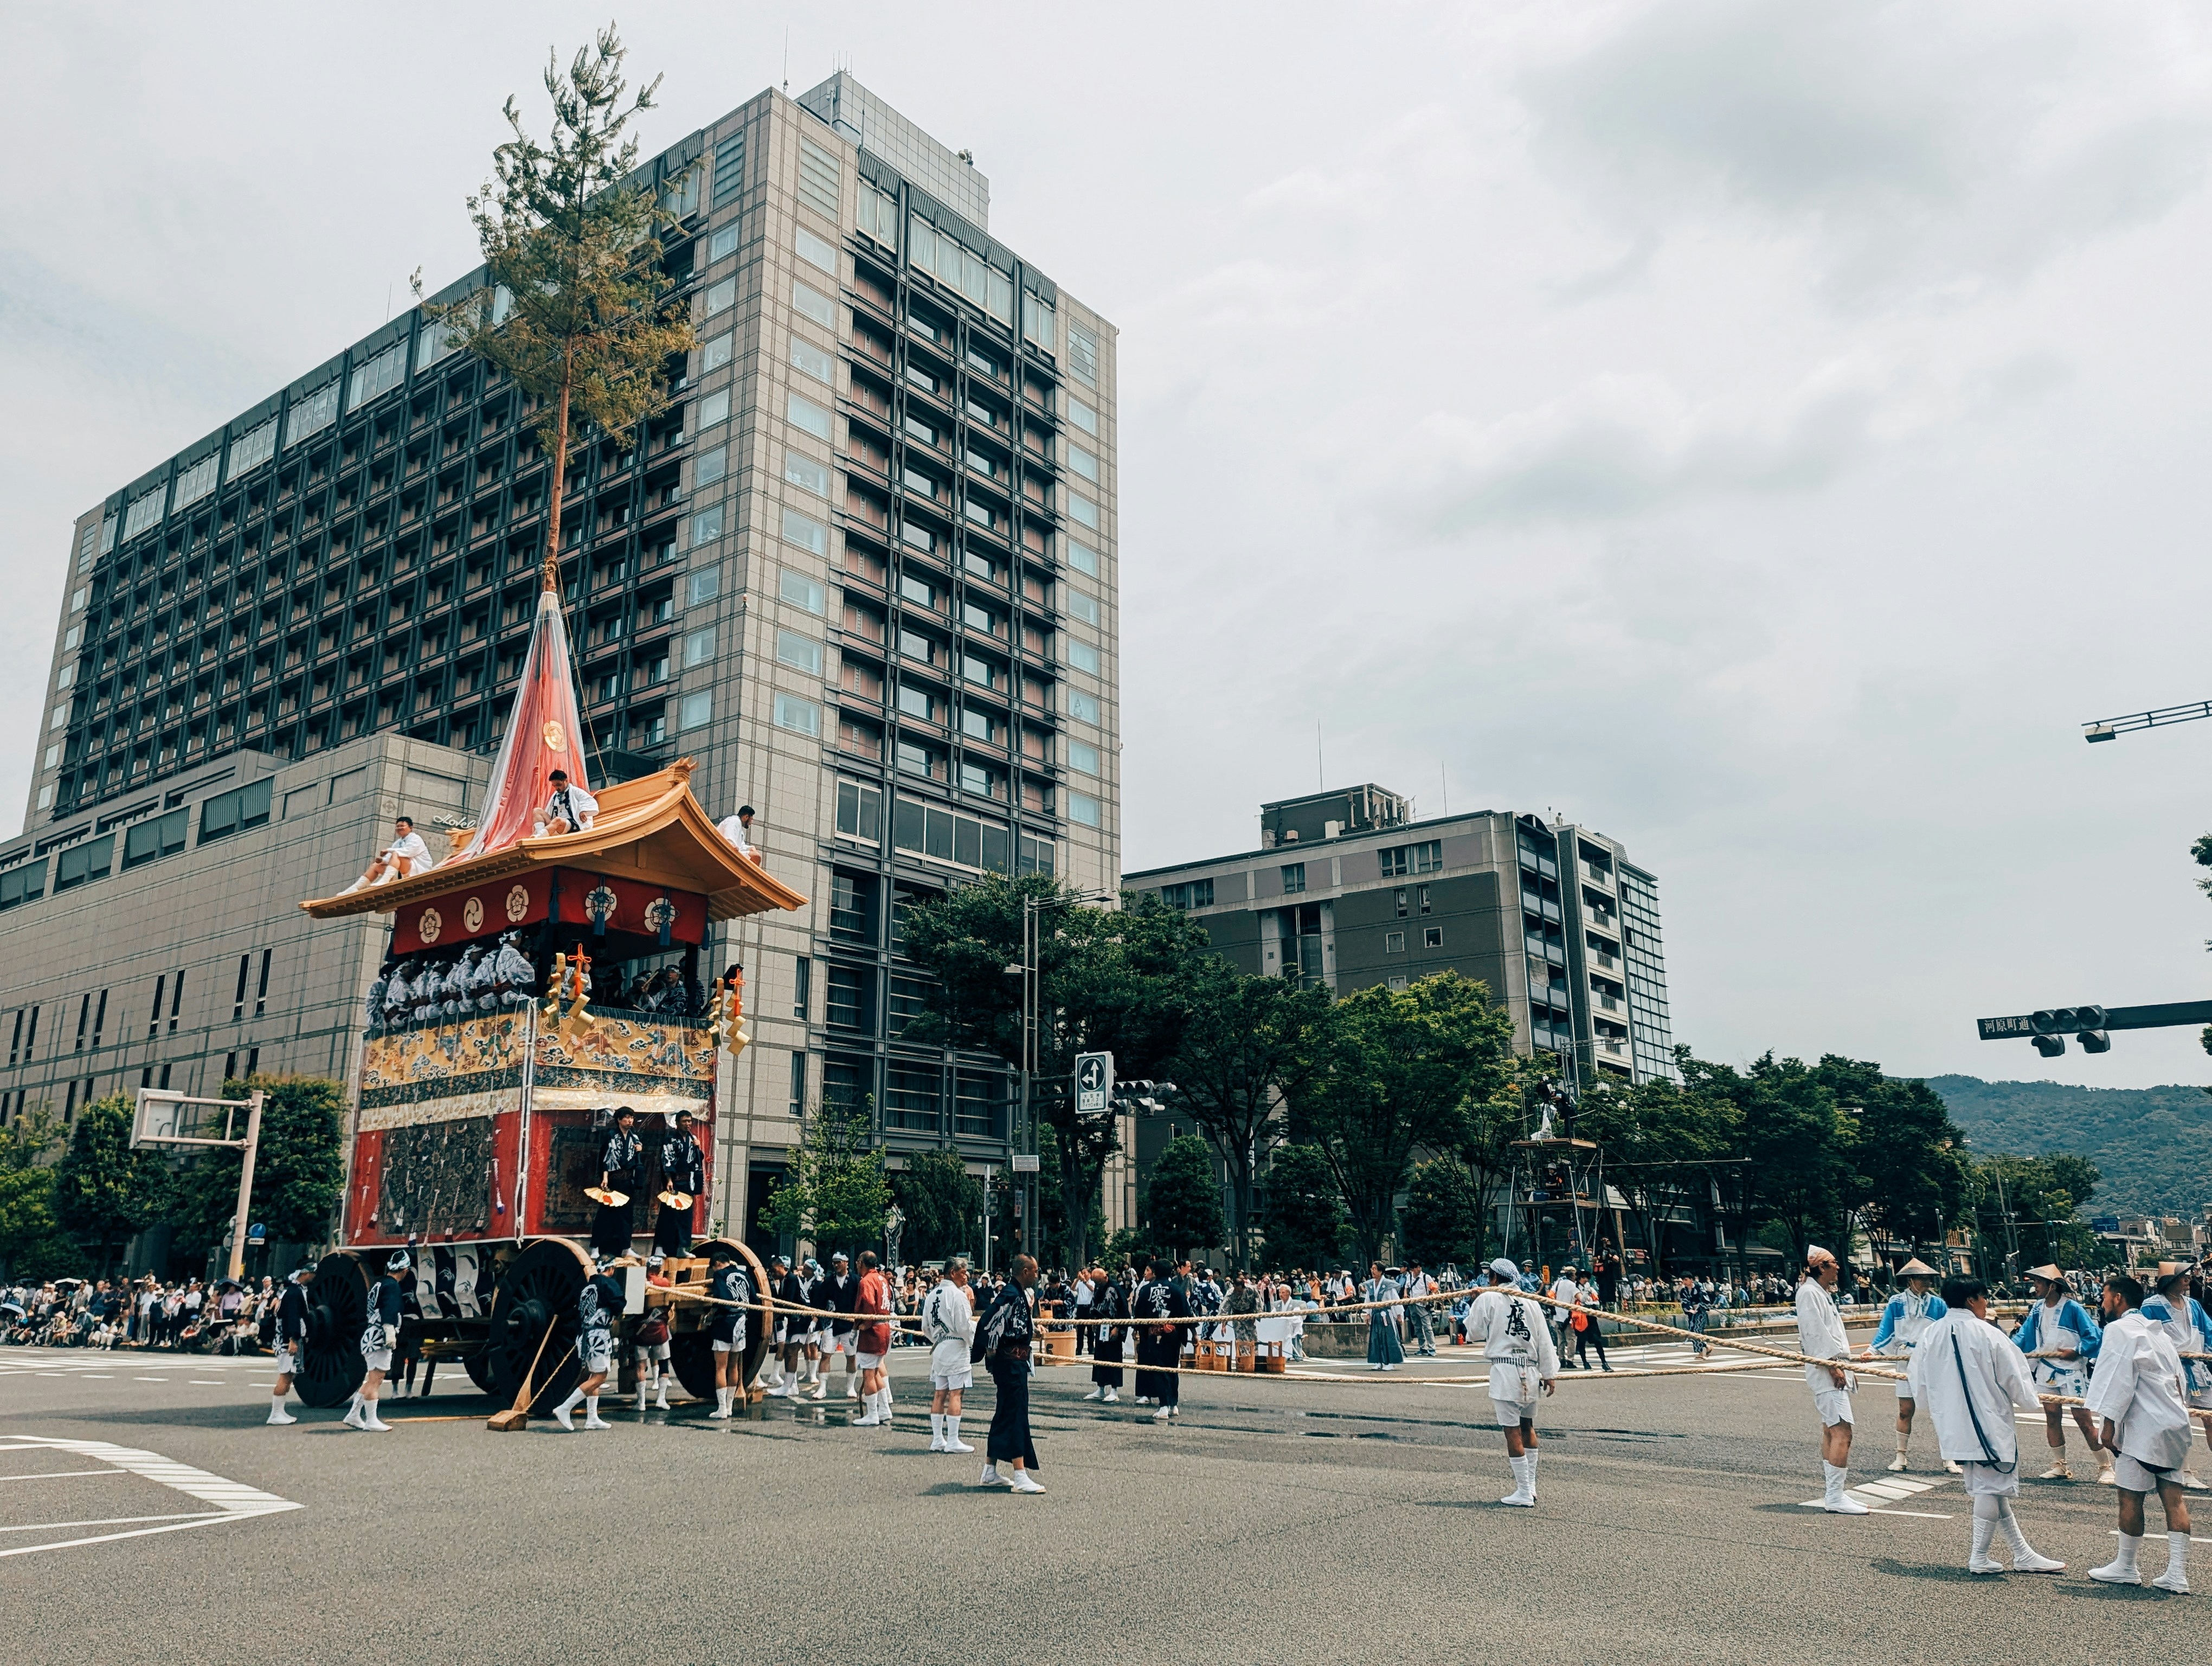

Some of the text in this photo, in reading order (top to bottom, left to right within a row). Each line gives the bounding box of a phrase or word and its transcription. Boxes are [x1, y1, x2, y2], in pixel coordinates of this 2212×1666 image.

[1984, 1017, 2030, 1033] 河原町通
[1505, 1299, 1531, 1342] 鷹
